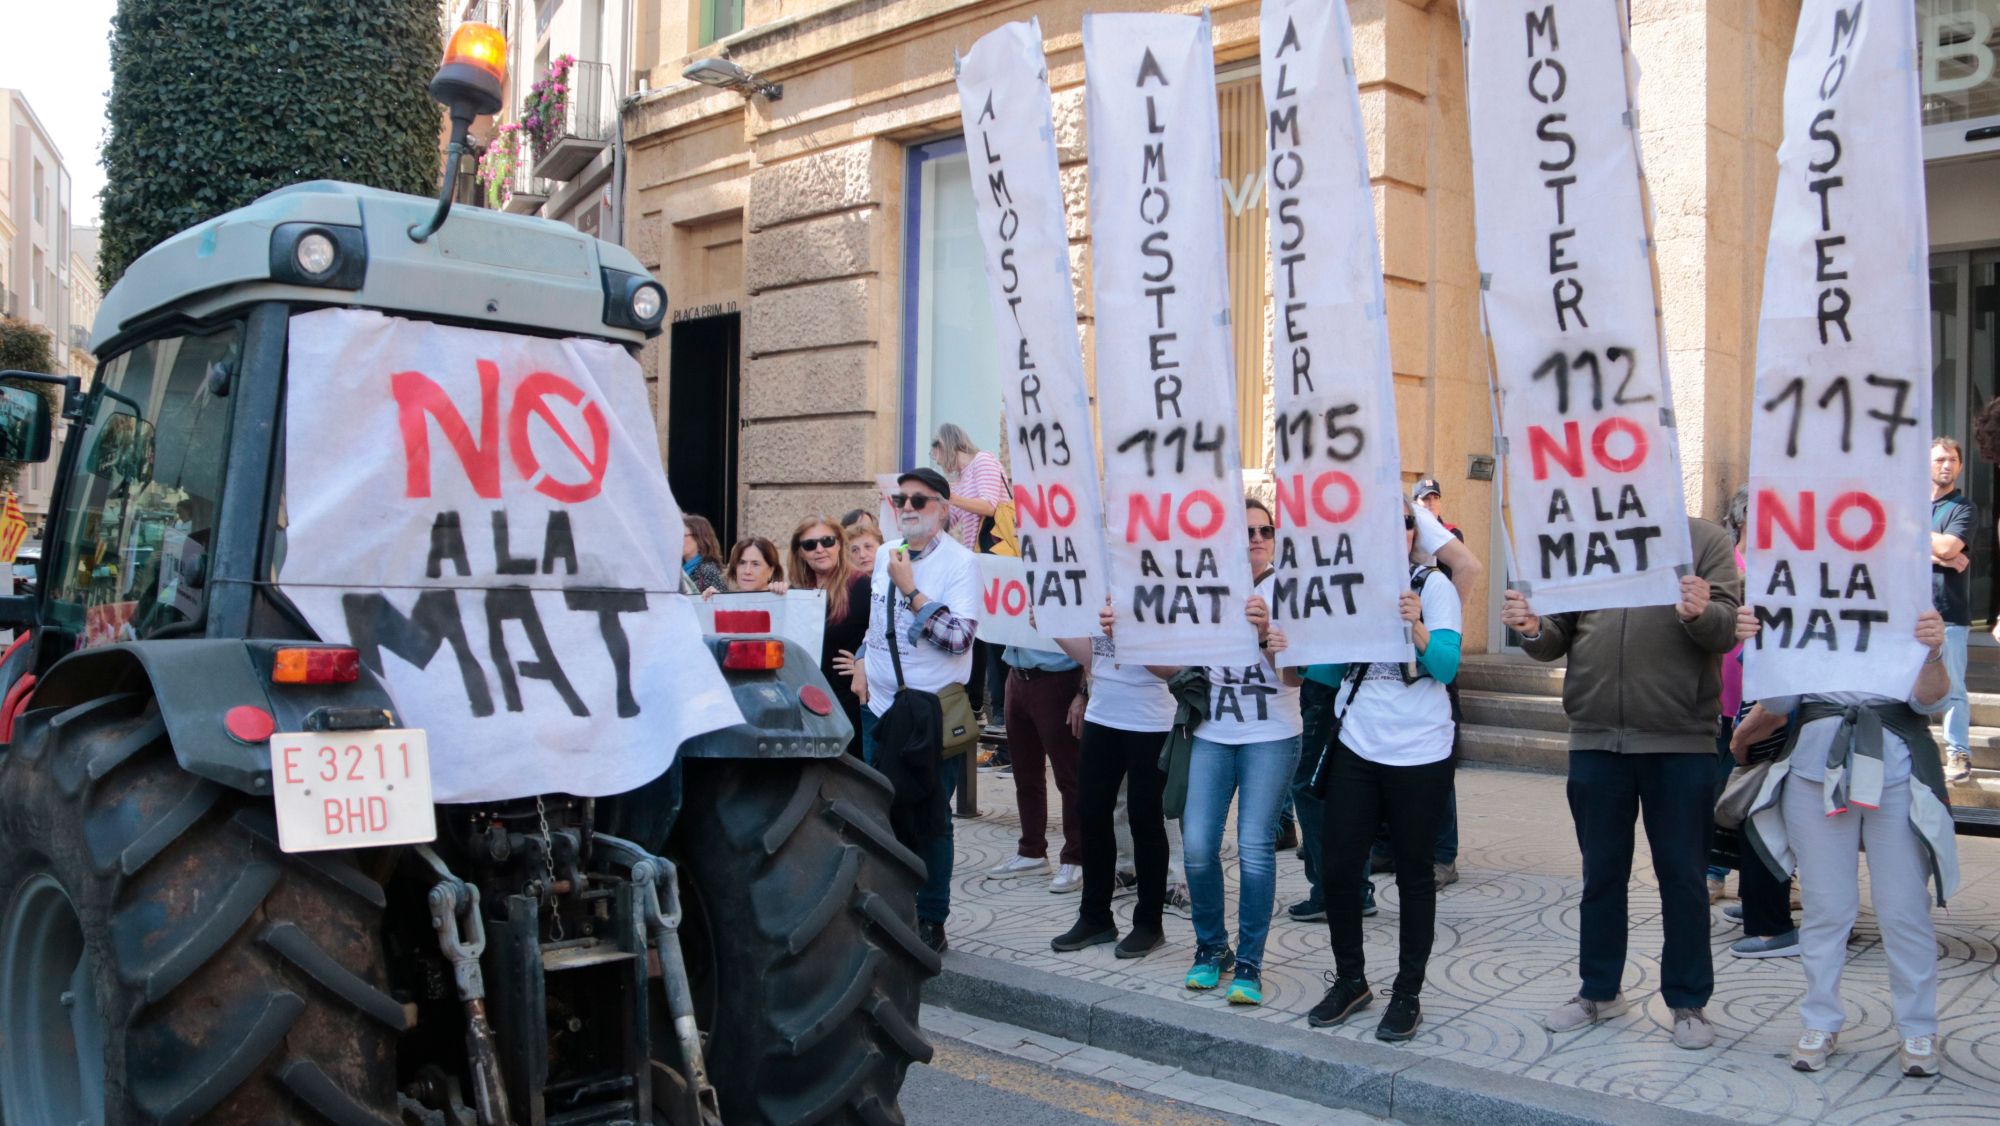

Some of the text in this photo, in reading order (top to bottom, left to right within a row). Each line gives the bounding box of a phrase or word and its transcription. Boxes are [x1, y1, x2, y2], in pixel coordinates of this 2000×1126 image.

[1269, 15, 1314, 395] ALMOSTER
[977, 87, 1041, 415] ALMOSTER
[1116, 46, 1182, 420] ALMOSTER
[727, 300, 737, 313] 10
[1532, 347, 1655, 414] 112
[390, 359, 610, 503] NO
[1275, 404, 1365, 462] 115
[1763, 374, 1918, 458] 117
[1019, 422, 1070, 471] 113
[1117, 420, 1225, 479] 114
[1528, 416, 1648, 480] NO
[1013, 483, 1076, 528] NO
[1126, 489, 1226, 543] NO
[1275, 471, 1361, 529] NO
[1547, 484, 1647, 524] A LA
[1756, 489, 1887, 552] NO
[426, 510, 578, 579] A LA
[1022, 535, 1078, 563] A LA
[1141, 548, 1219, 578] A LA
[1279, 533, 1354, 569] A LA
[1538, 526, 1661, 579] MAT
[1133, 585, 1230, 624] MAT
[1272, 573, 1364, 620] MAT
[1766, 560, 1876, 599] A LA
[342, 584, 648, 718] MAT
[1754, 605, 1888, 652] MAT
[1205, 685, 1277, 722] AT
[318, 742, 409, 782] 3211
[323, 796, 388, 835] BHD
